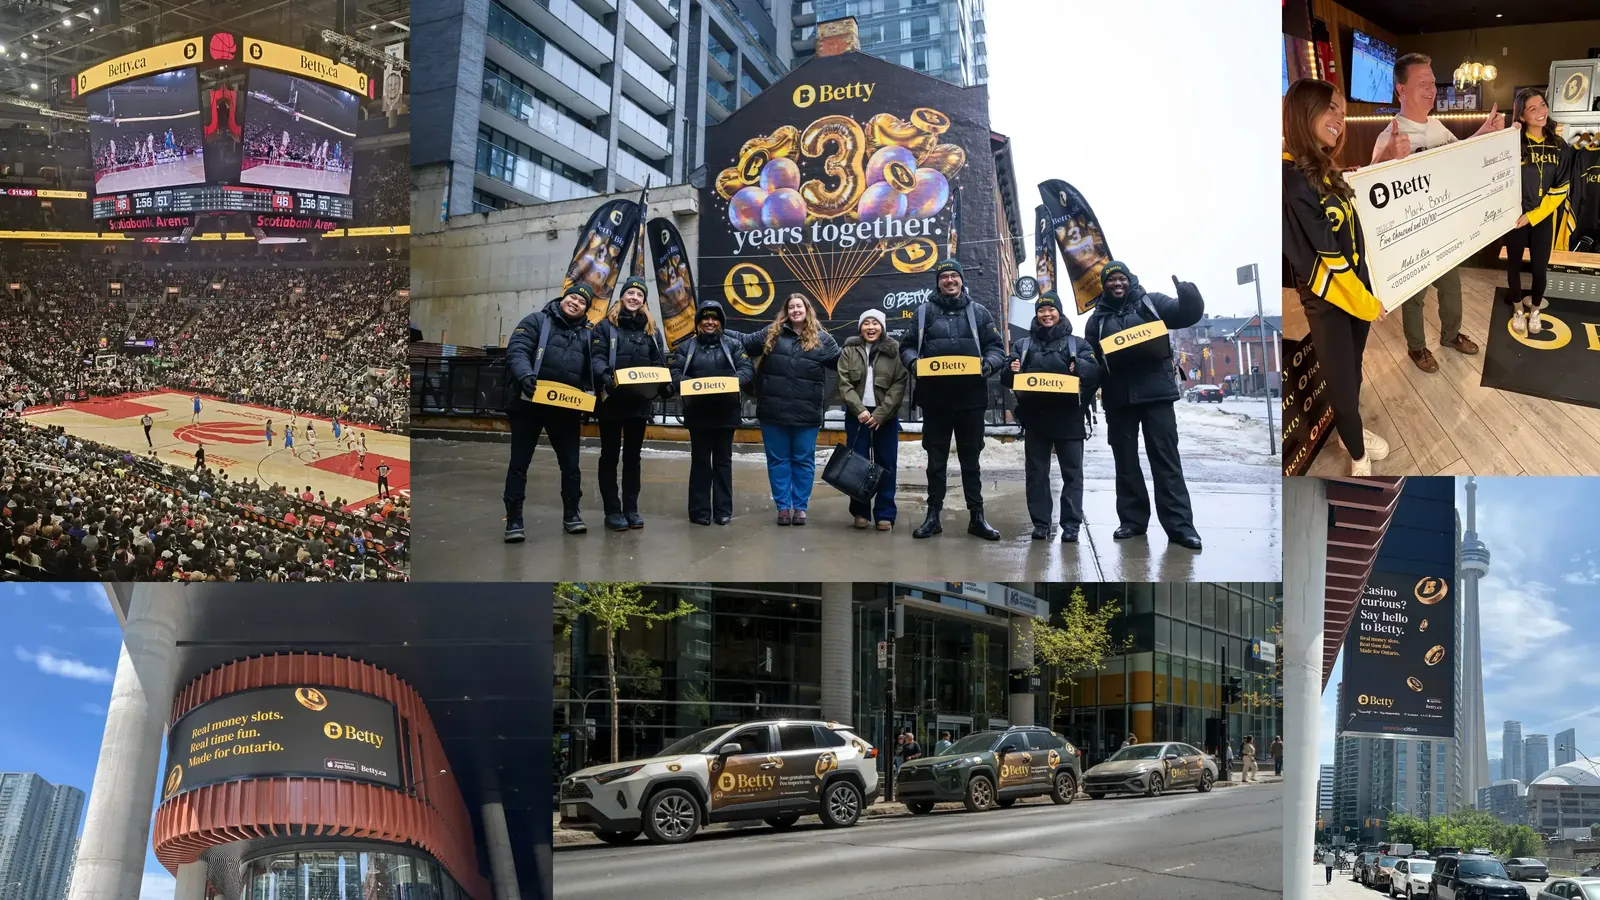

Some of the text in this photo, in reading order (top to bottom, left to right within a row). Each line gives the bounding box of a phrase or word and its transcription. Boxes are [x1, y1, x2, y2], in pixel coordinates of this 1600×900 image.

[107, 57, 147, 77] Betty.ca
[300, 54, 338, 79] Betty.ca
[819, 81, 876, 103] Betty
[800, 114, 867, 219] 3
[1391, 173, 1432, 201] Betty
[117, 200, 127, 210] 46
[135, 197, 153, 208] 1:56
[157, 196, 169, 207] 51
[276, 196, 289, 207] 46
[299, 198, 316, 209] 1:56
[319, 200, 328, 211] 51
[109, 216, 189, 230] Scotiabank Arena
[257, 215, 338, 230] Scotiabank Arena
[733, 213, 942, 255] years together.
[1379, 233, 1392, 248] Five
[1126, 328, 1152, 342] Betty
[942, 361, 968, 372] Betty
[638, 371, 660, 380] Betty
[703, 382, 727, 390] Betty
[1039, 378, 1065, 389] Betty
[558, 392, 584, 406] Betty
[1282, 413, 1300, 442] etty
[1285, 443, 1307, 476] Betty
[1362, 584, 1397, 597] Casino
[1361, 598, 1407, 610] curious?
[1360, 609, 1409, 624] Say hello
[1360, 622, 1405, 637] to Betty.
[1370, 695, 1394, 708] Betty
[192, 711, 284, 739] Real money slots.
[190, 728, 261, 753] Real time fun.
[344, 724, 384, 749] Betty
[188, 740, 284, 768] Made for Ontario.
[361, 764, 387, 777] Betty.ca
[1010, 764, 1029, 777] Betty
[737, 773, 776, 790] Betty
